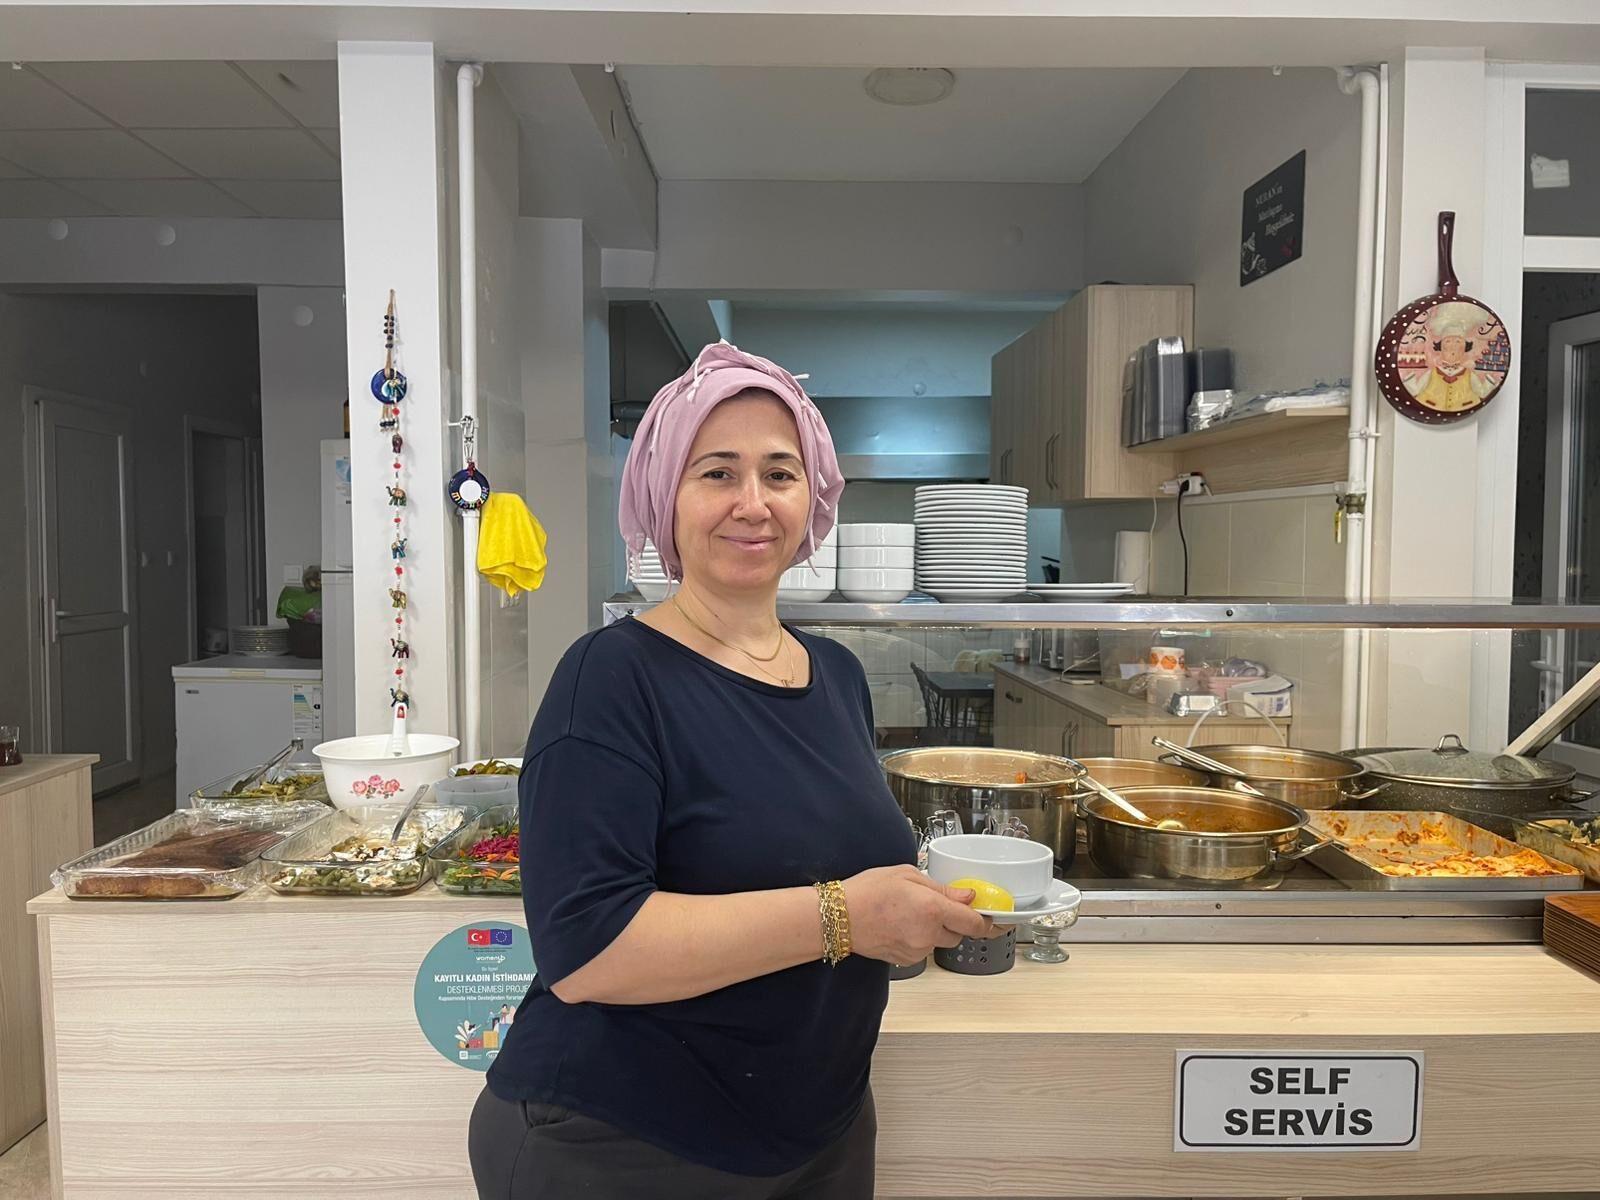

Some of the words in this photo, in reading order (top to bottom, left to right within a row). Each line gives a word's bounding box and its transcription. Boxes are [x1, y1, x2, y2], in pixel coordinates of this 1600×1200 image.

[435, 974, 464, 982] KAYITLI
[466, 974, 490, 982] KADIN
[447, 984, 504, 994] DESTEKLENMESİ
[1249, 1066, 1351, 1095] SELF
[1223, 1102, 1373, 1136] SERVİS
